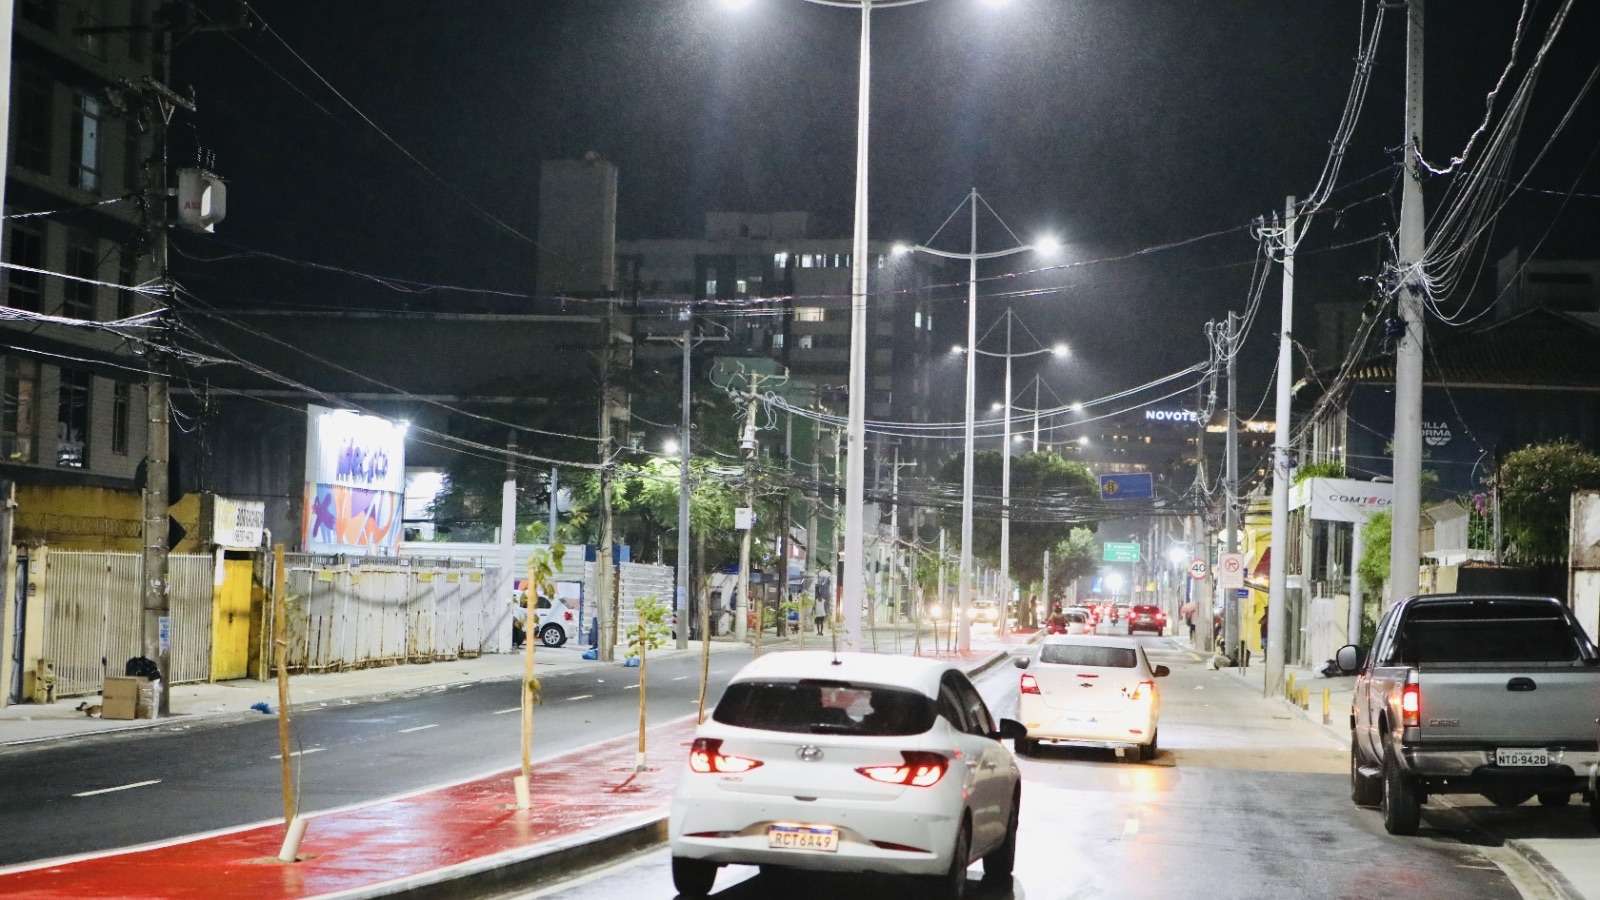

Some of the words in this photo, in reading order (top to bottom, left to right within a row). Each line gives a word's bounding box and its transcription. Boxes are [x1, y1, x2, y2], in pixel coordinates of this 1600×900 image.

[1145, 410, 1198, 422] NOVOTE
[1422, 421, 1448, 429] ILLA
[1192, 563, 1206, 572] 40
[775, 832, 832, 848] RCT6A49
